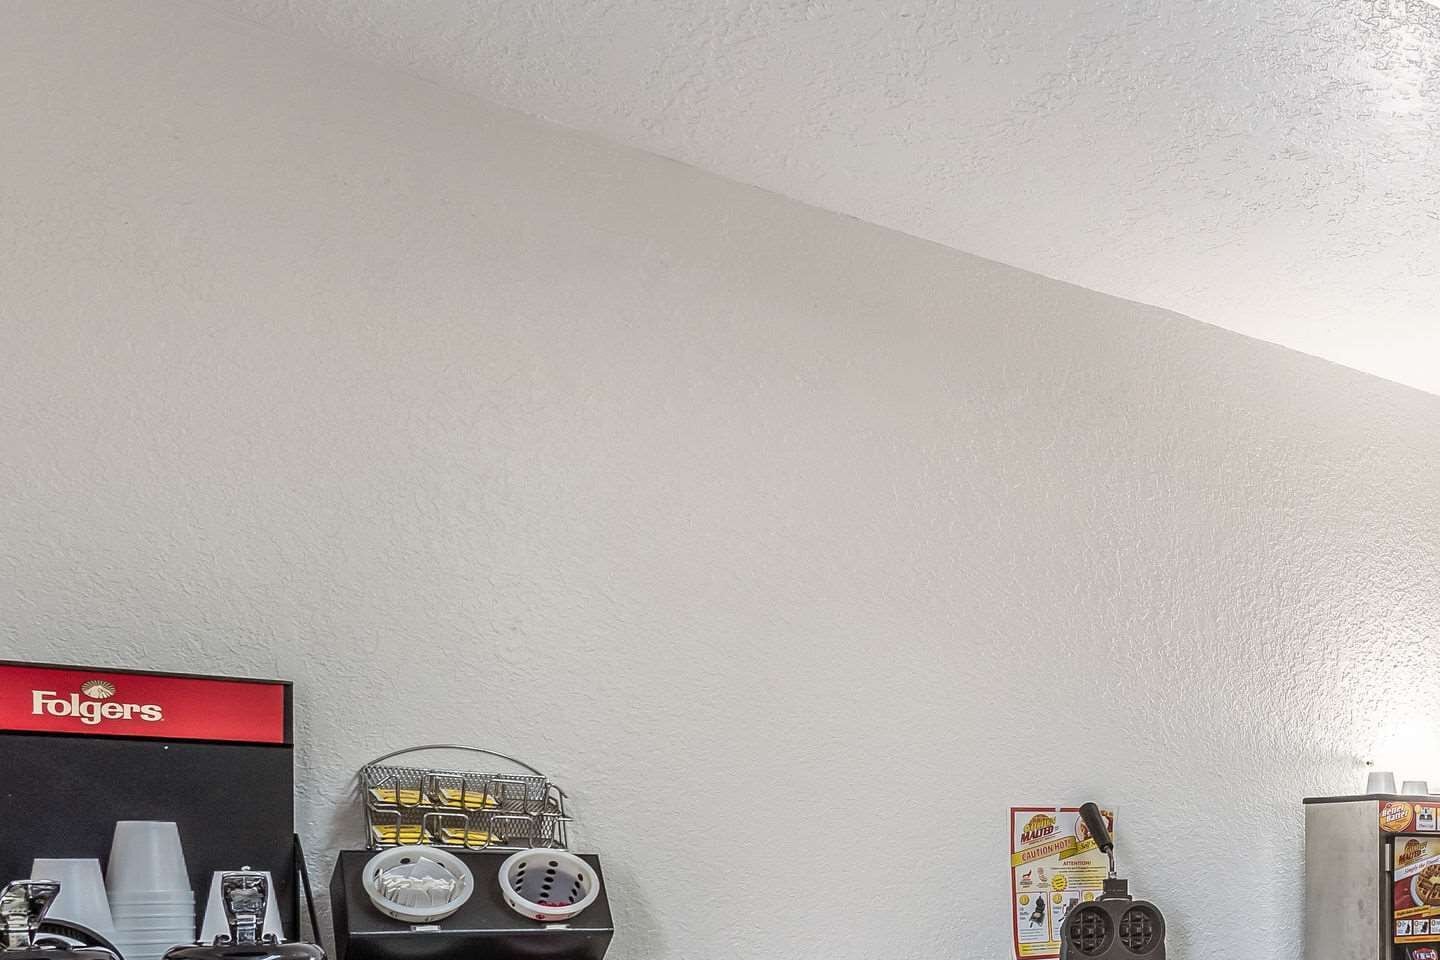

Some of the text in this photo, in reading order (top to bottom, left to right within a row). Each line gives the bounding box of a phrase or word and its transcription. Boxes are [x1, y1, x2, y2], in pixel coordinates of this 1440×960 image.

[32, 690, 163, 725] Folgers
[1021, 825, 1054, 843] MALTED
[1021, 844, 1053, 862] CAUTION
